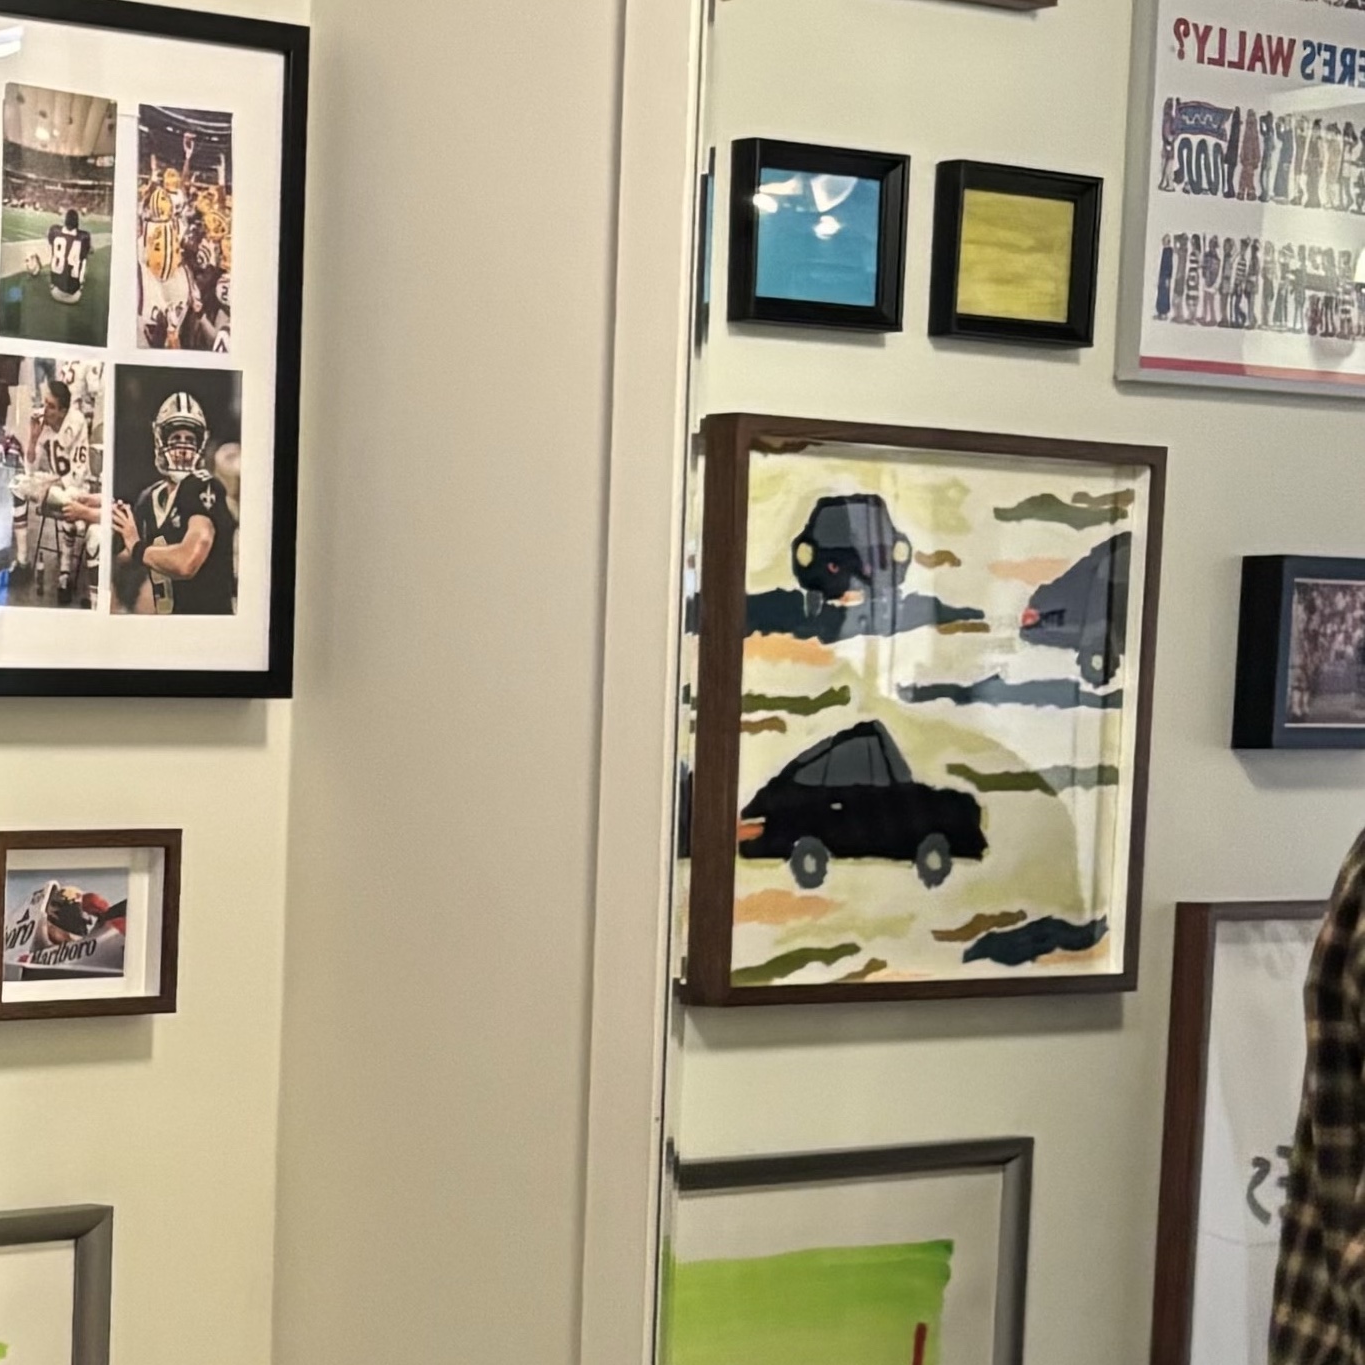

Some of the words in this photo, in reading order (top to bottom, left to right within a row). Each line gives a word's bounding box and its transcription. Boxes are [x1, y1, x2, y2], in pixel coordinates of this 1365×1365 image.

[51, 236, 82, 279] 84
[44, 439, 72, 477] 16
[30, 938, 97, 967] Marlboro
